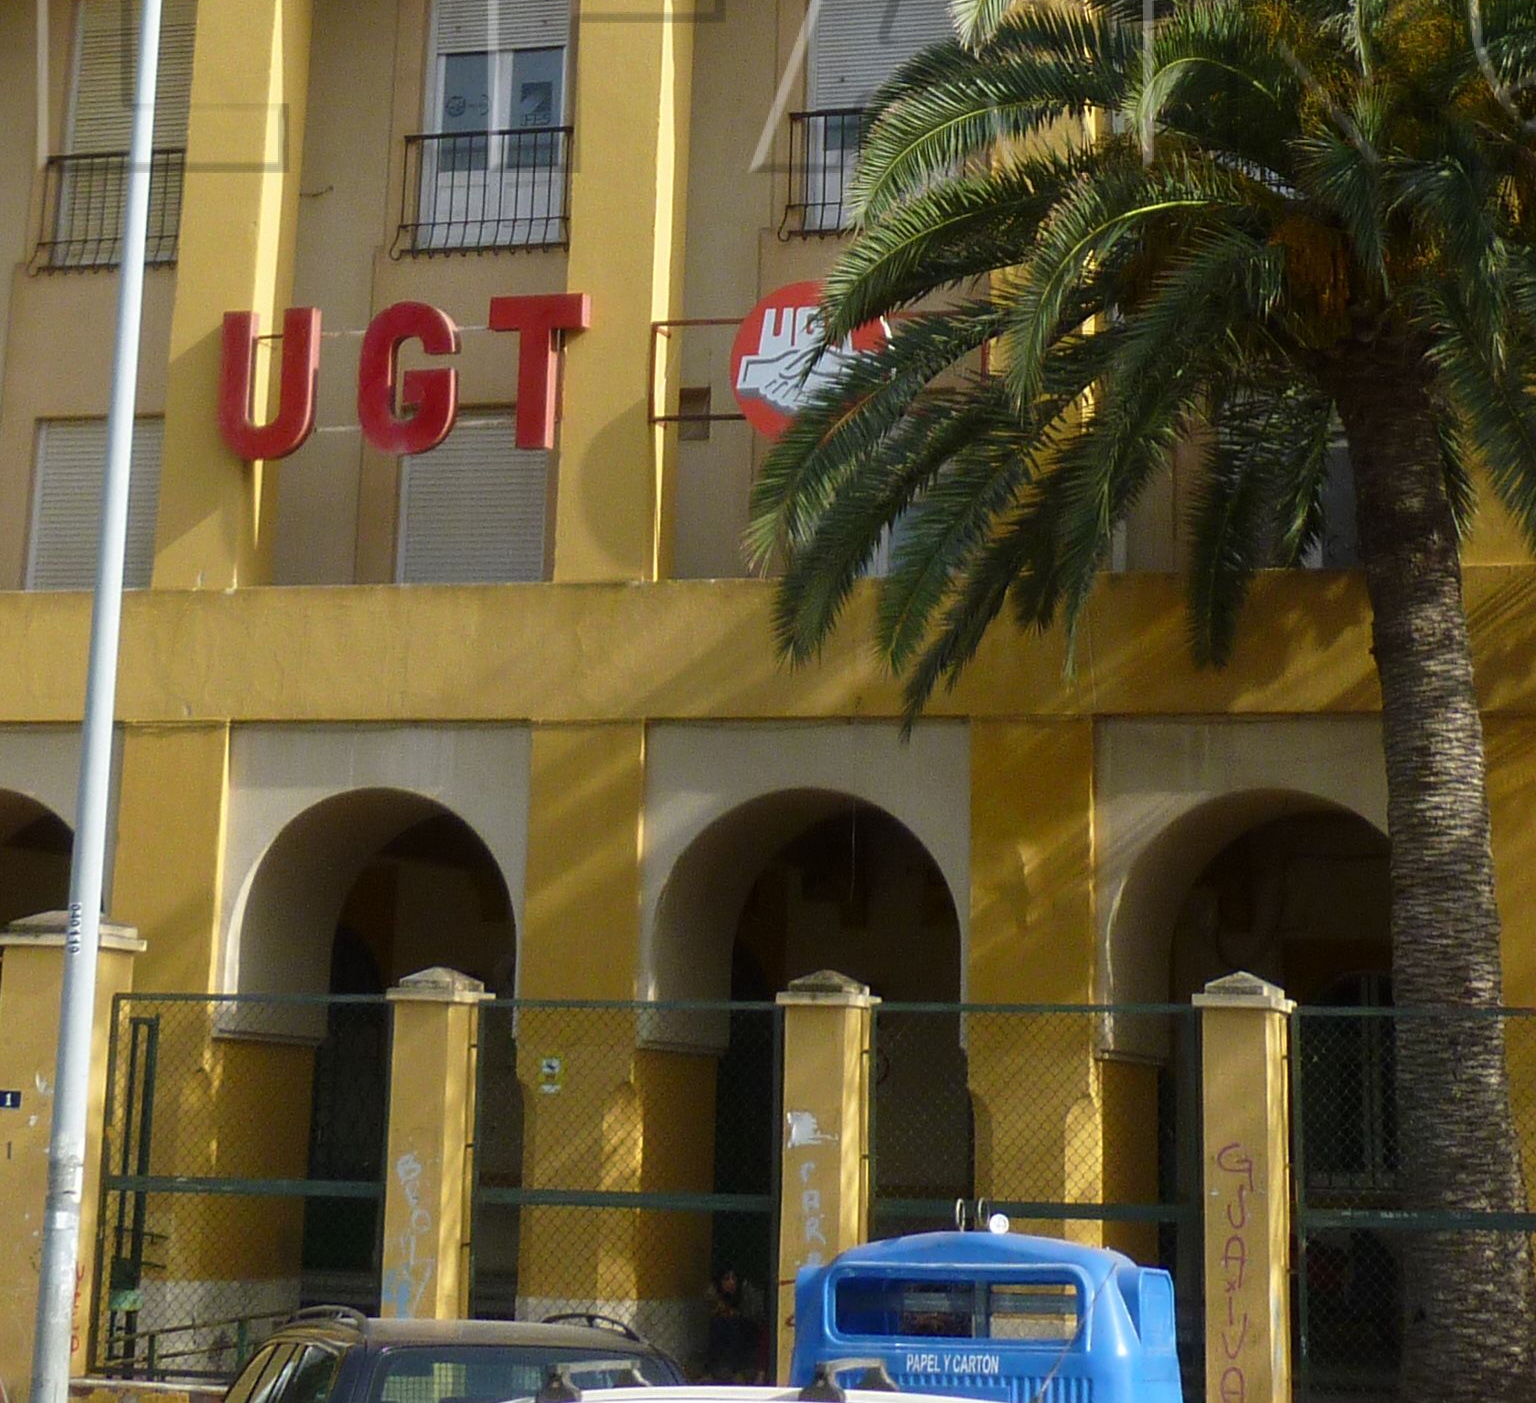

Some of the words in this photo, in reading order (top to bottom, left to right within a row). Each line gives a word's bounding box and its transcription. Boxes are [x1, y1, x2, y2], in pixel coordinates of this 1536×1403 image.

[757, 305, 855, 352] UG
[218, 292, 591, 460] UGT
[5, 1093, 12, 1106] 1
[906, 1353, 941, 1373] PAPEL
[943, 1354, 951, 1373] Y
